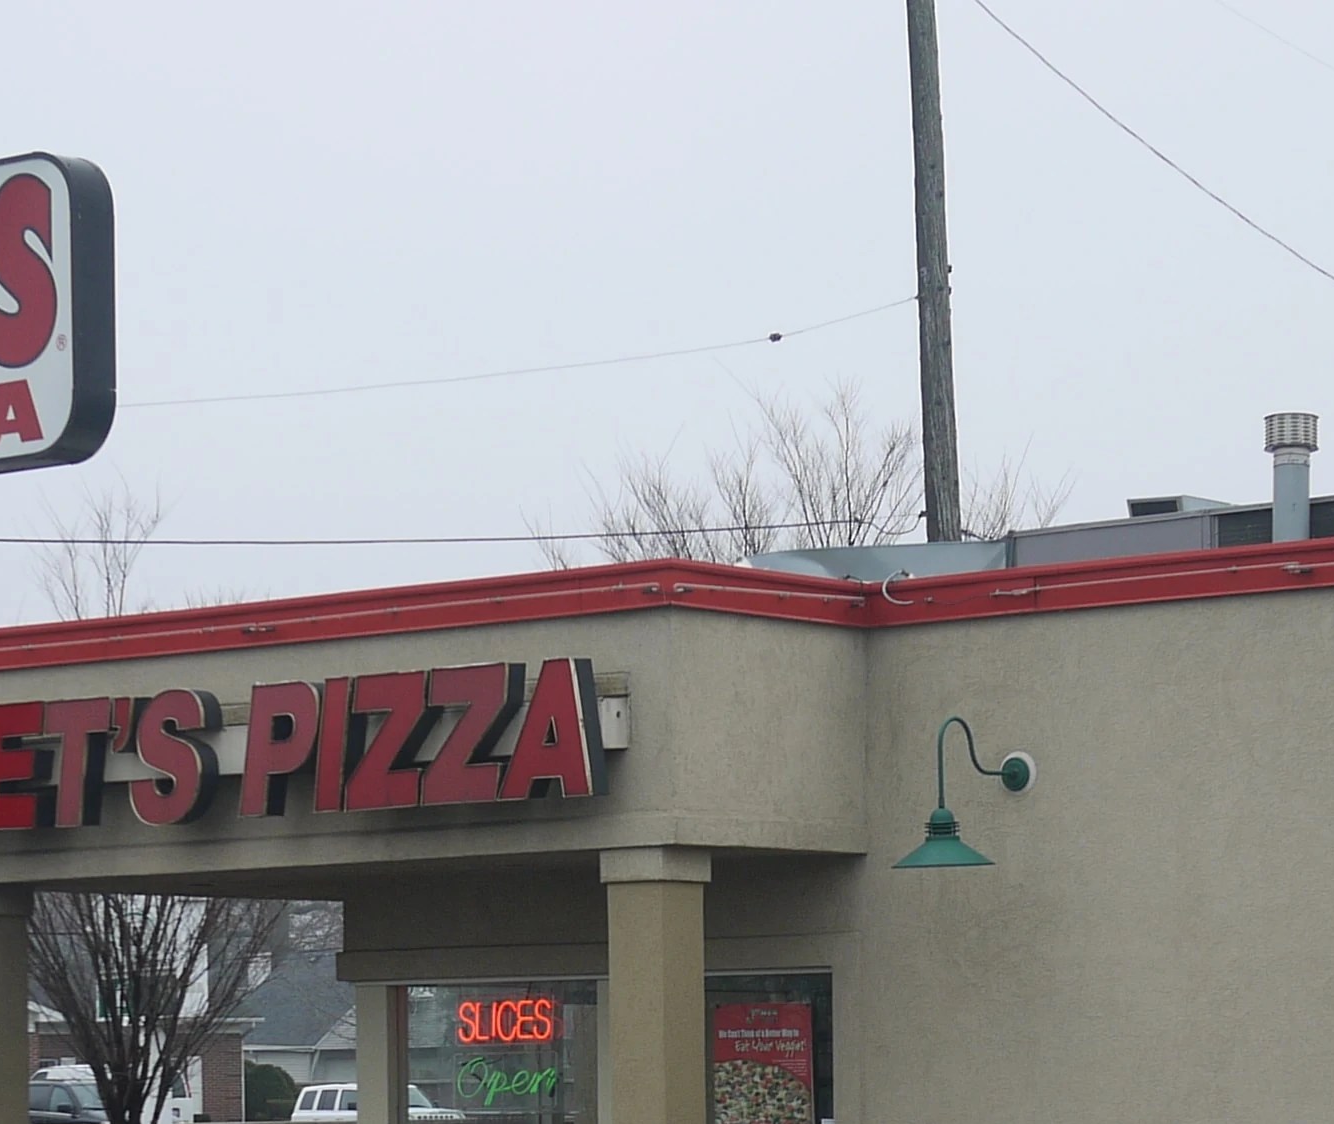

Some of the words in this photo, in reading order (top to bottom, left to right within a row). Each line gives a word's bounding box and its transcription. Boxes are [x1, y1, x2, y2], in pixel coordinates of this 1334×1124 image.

[238, 656, 602, 820] PIZZA
[458, 999, 553, 1042] SLICES
[458, 1056, 556, 1107] Open
